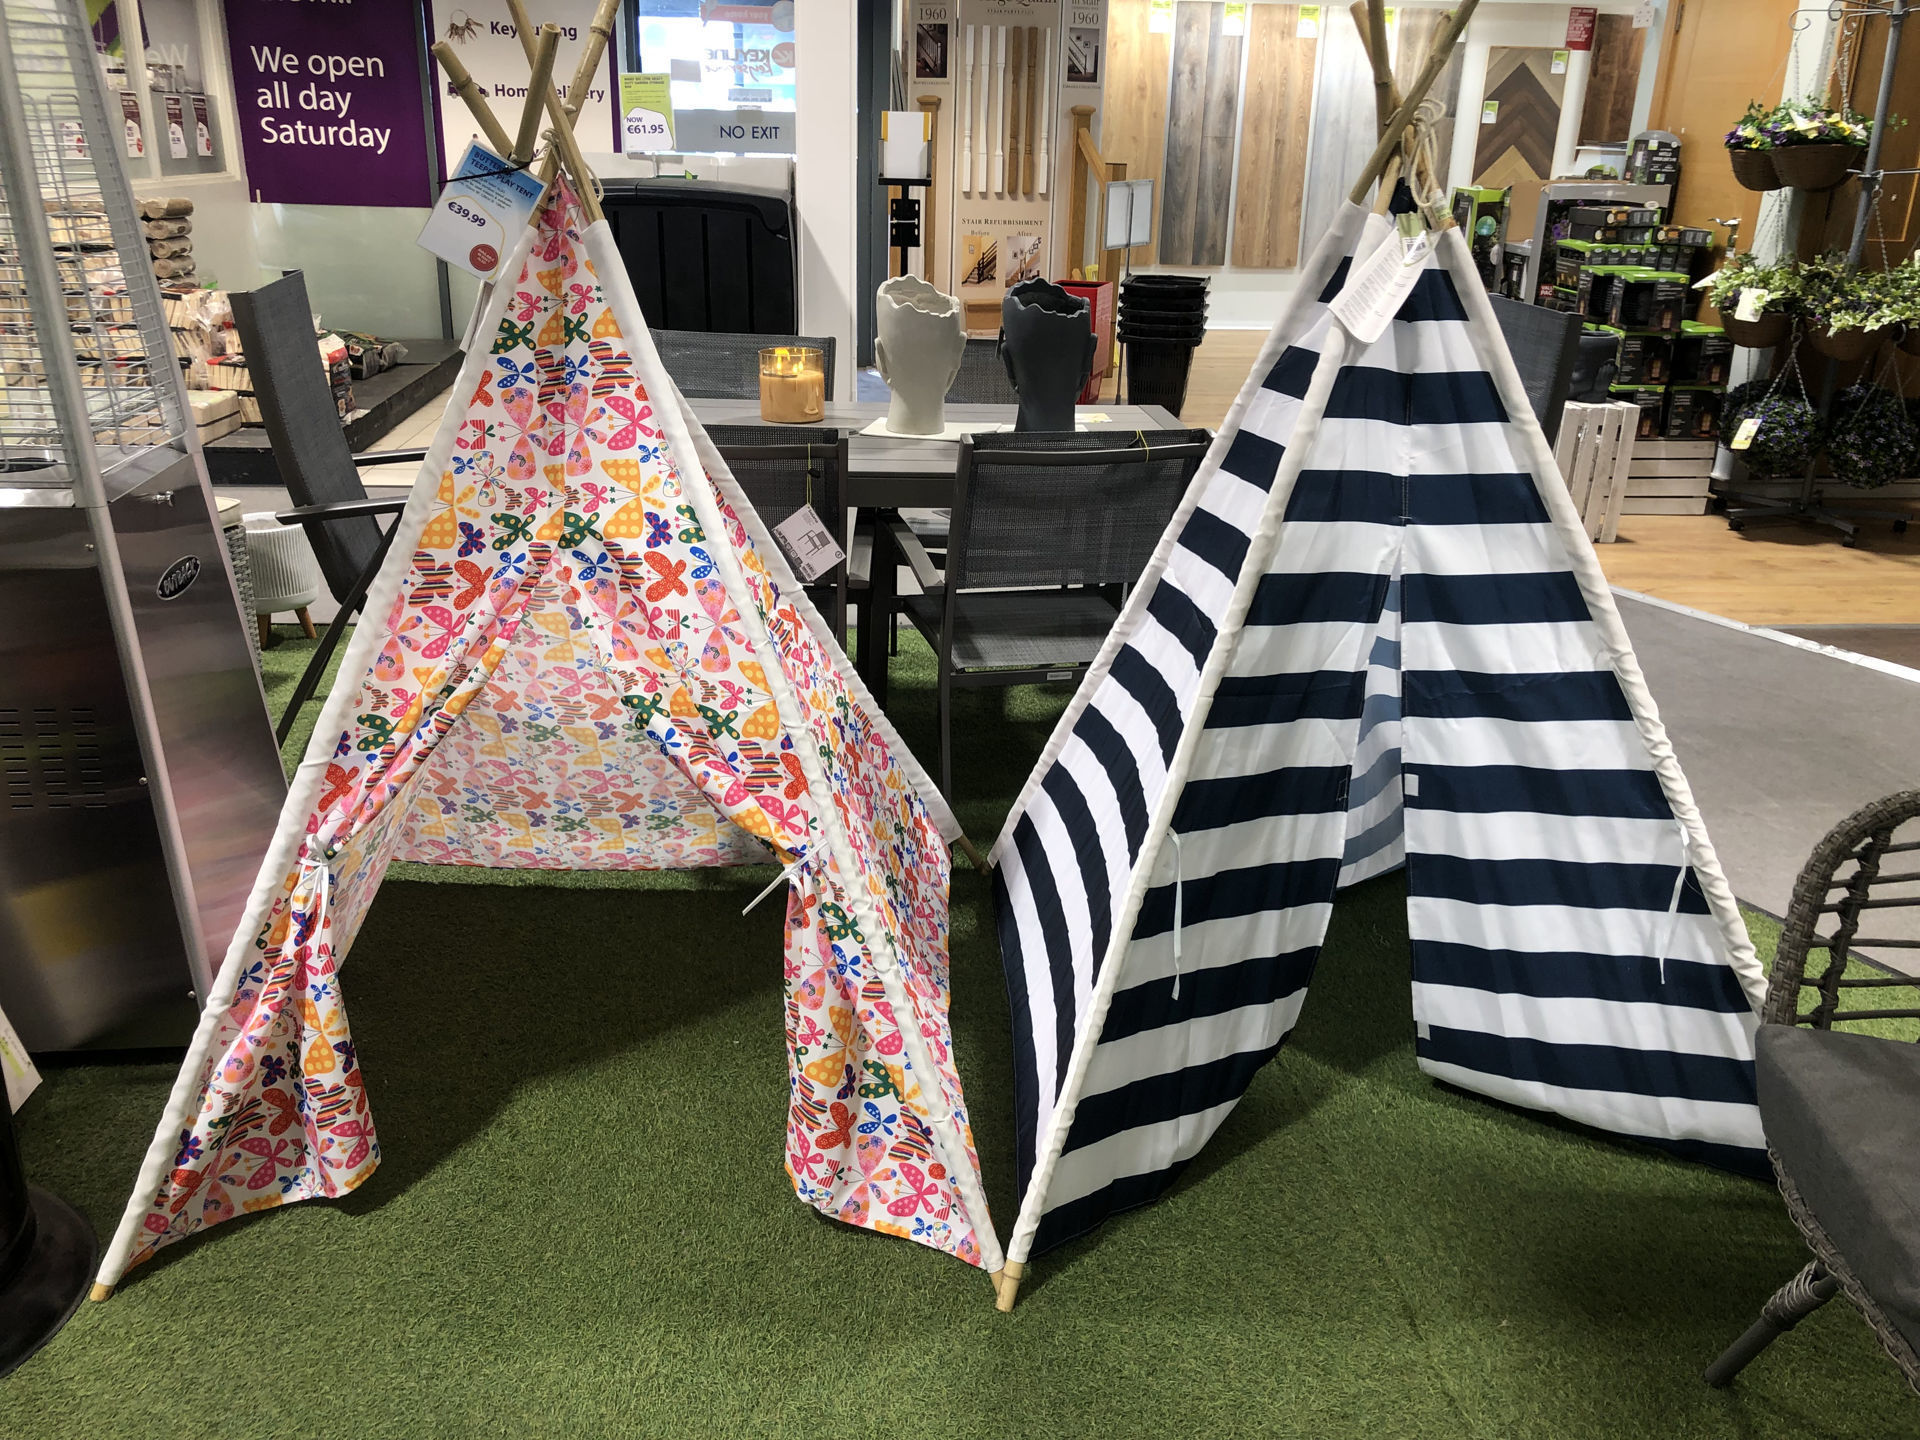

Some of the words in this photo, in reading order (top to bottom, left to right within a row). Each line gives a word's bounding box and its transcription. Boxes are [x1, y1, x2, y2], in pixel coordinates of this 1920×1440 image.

[920, 7, 947, 20] 1960
[1073, 11, 1099, 25] 1960
[490, 21, 518, 39] Key
[250, 46, 299, 74] We
[307, 54, 385, 82] open
[257, 81, 290, 109] all
[299, 82, 352, 118] day
[495, 84, 528, 98] Hom
[260, 117, 391, 154] Saturday
[627, 124, 664, 134] €61.95
[720, 126, 745, 139] NO
[752, 126, 780, 140] EXIT
[496, 174, 517, 188] PLAY
[516, 184, 535, 199] TENT
[448, 201, 487, 227] €39.99
